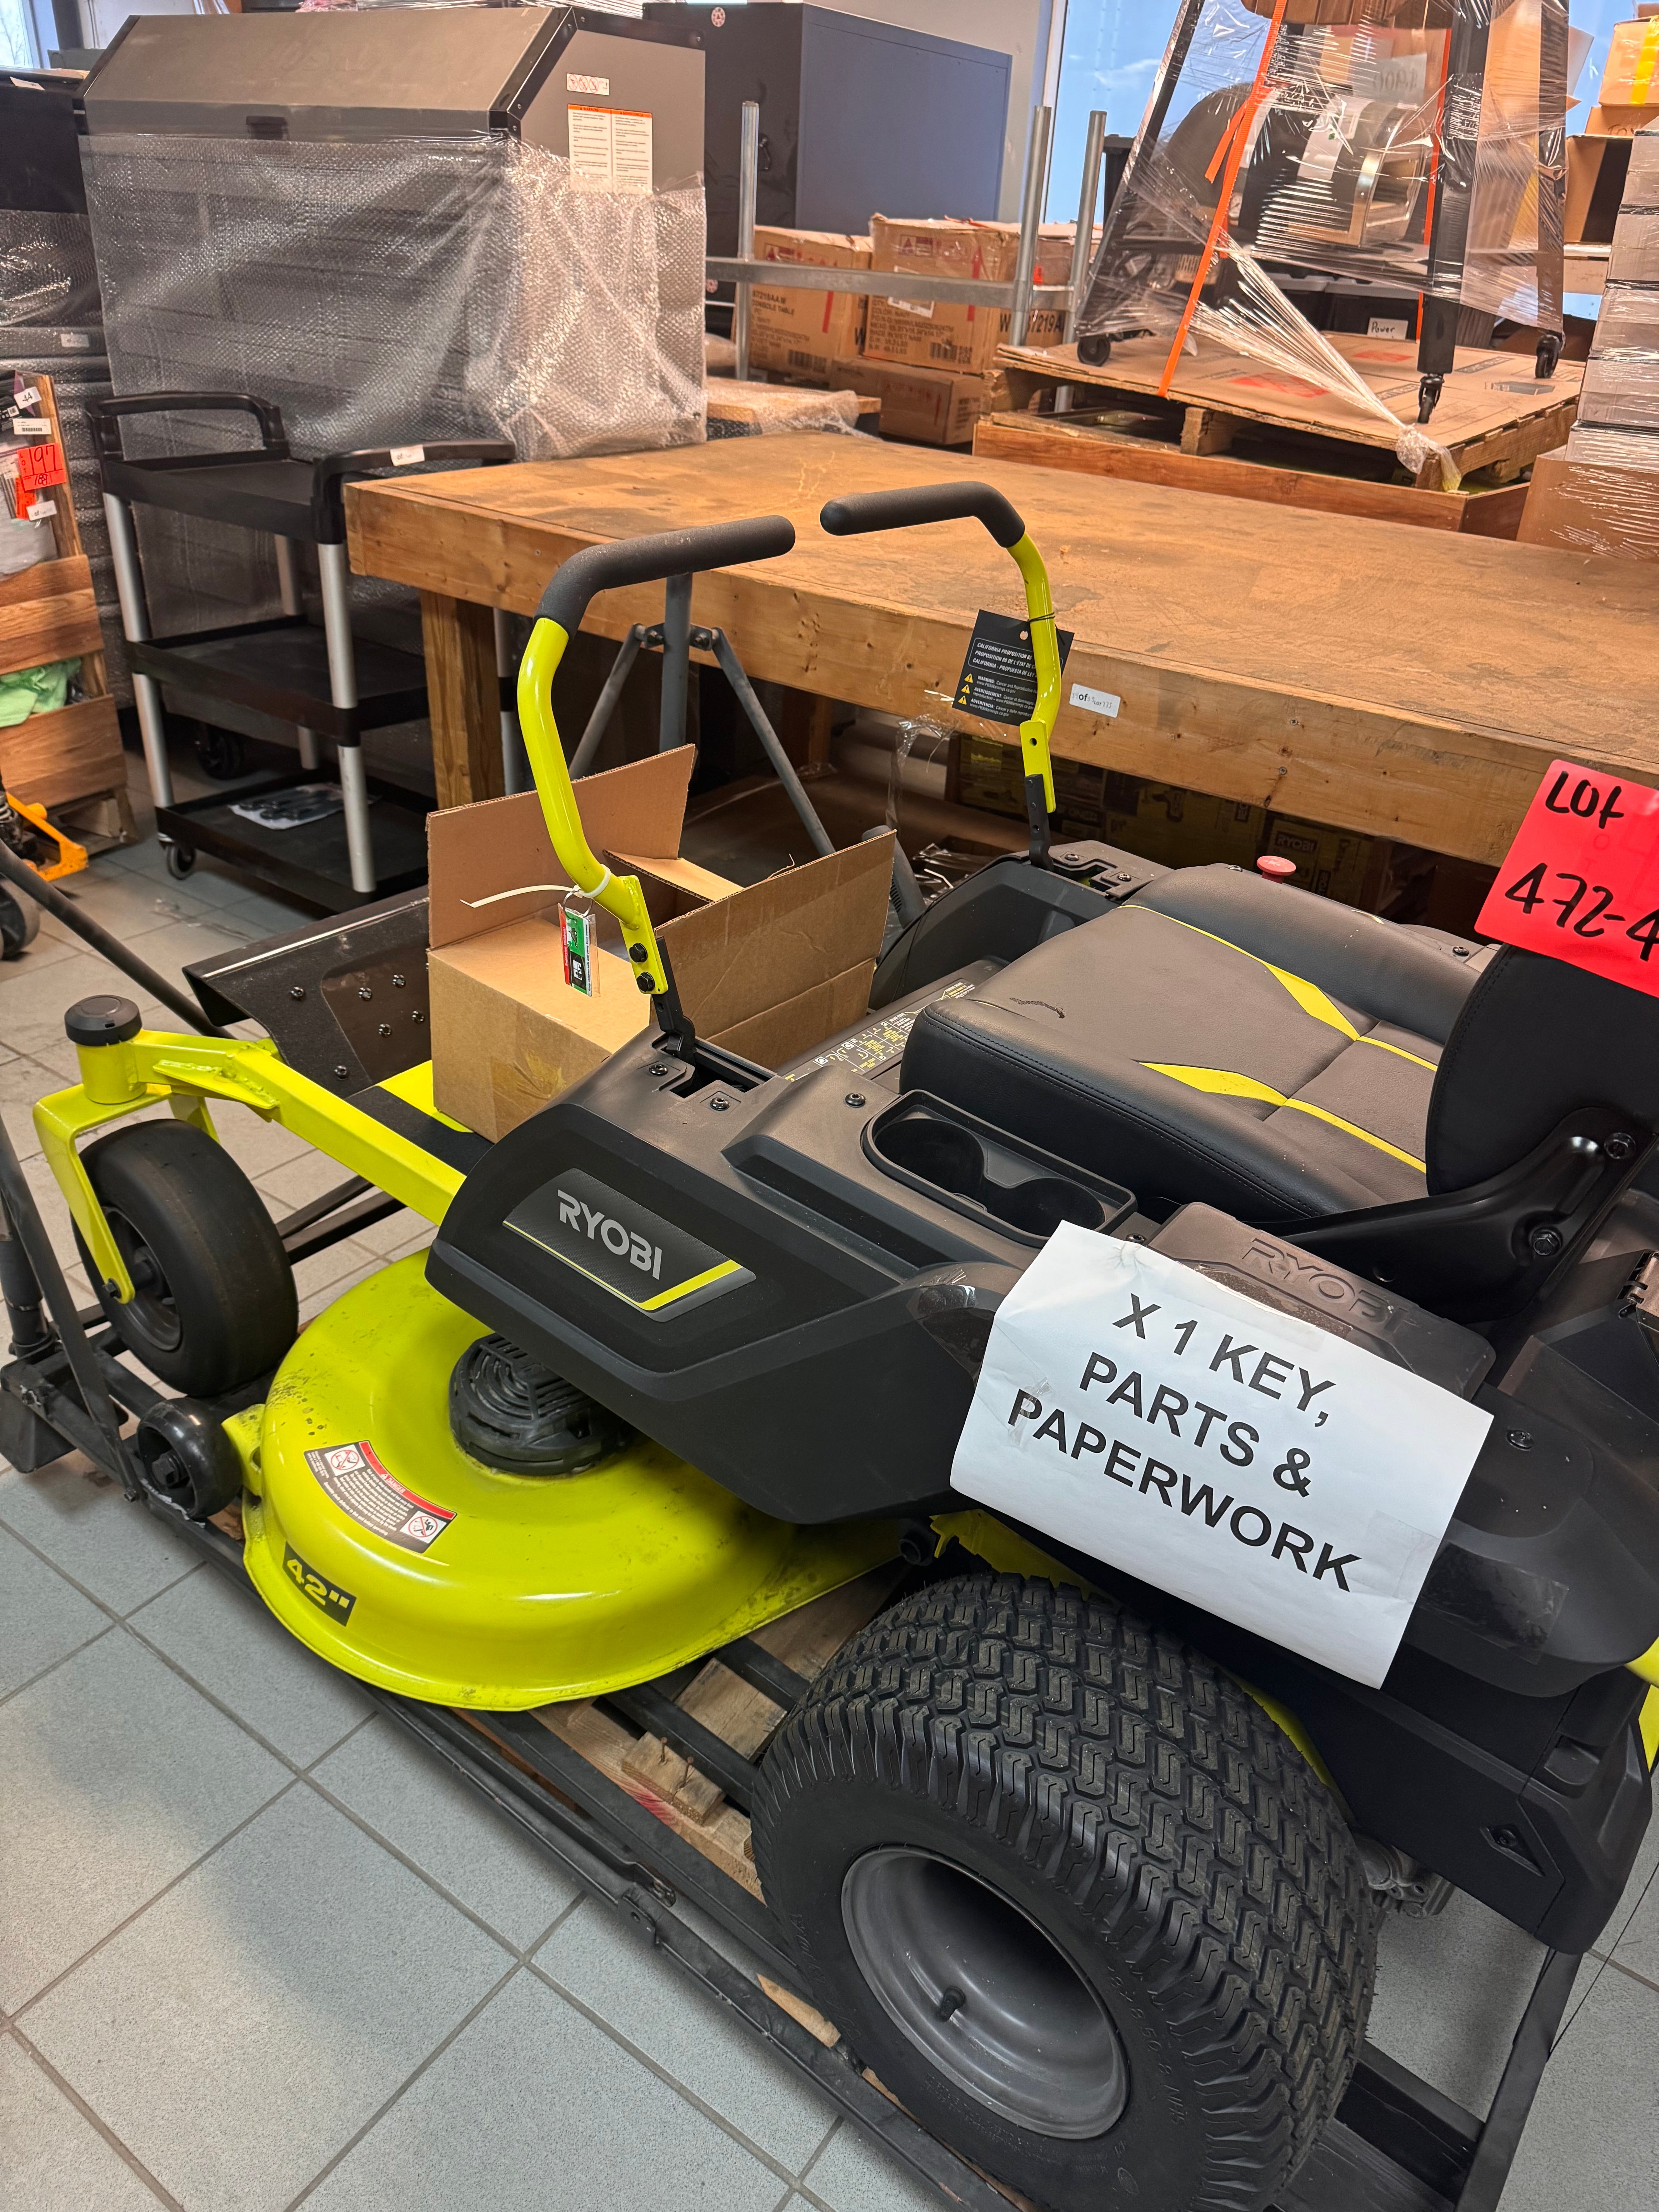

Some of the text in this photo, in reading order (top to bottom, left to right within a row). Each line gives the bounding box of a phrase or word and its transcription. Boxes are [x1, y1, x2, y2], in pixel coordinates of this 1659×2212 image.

[973, 658, 996, 668] CALIFORNIA
[999, 665, 1021, 674] PROPUESTA
[975, 650, 1002, 661] PROPOSITION
[977, 642, 1001, 653] CALIFORNIA
[1001, 649, 1027, 658] PROPOSITION
[978, 675, 995, 684] WARNING:
[557, 1189, 662, 1280] RYOBI
[1242, 1238, 1408, 1334] RYOBI
[1112, 1293, 1336, 1427] X 1 KEY,
[1079, 1352, 1311, 1497] PARTS &
[386, 1477, 406, 1494] DANGER
[1008, 1389, 1362, 1592] PAPERWORK
[287, 1559, 350, 1608] 42"
